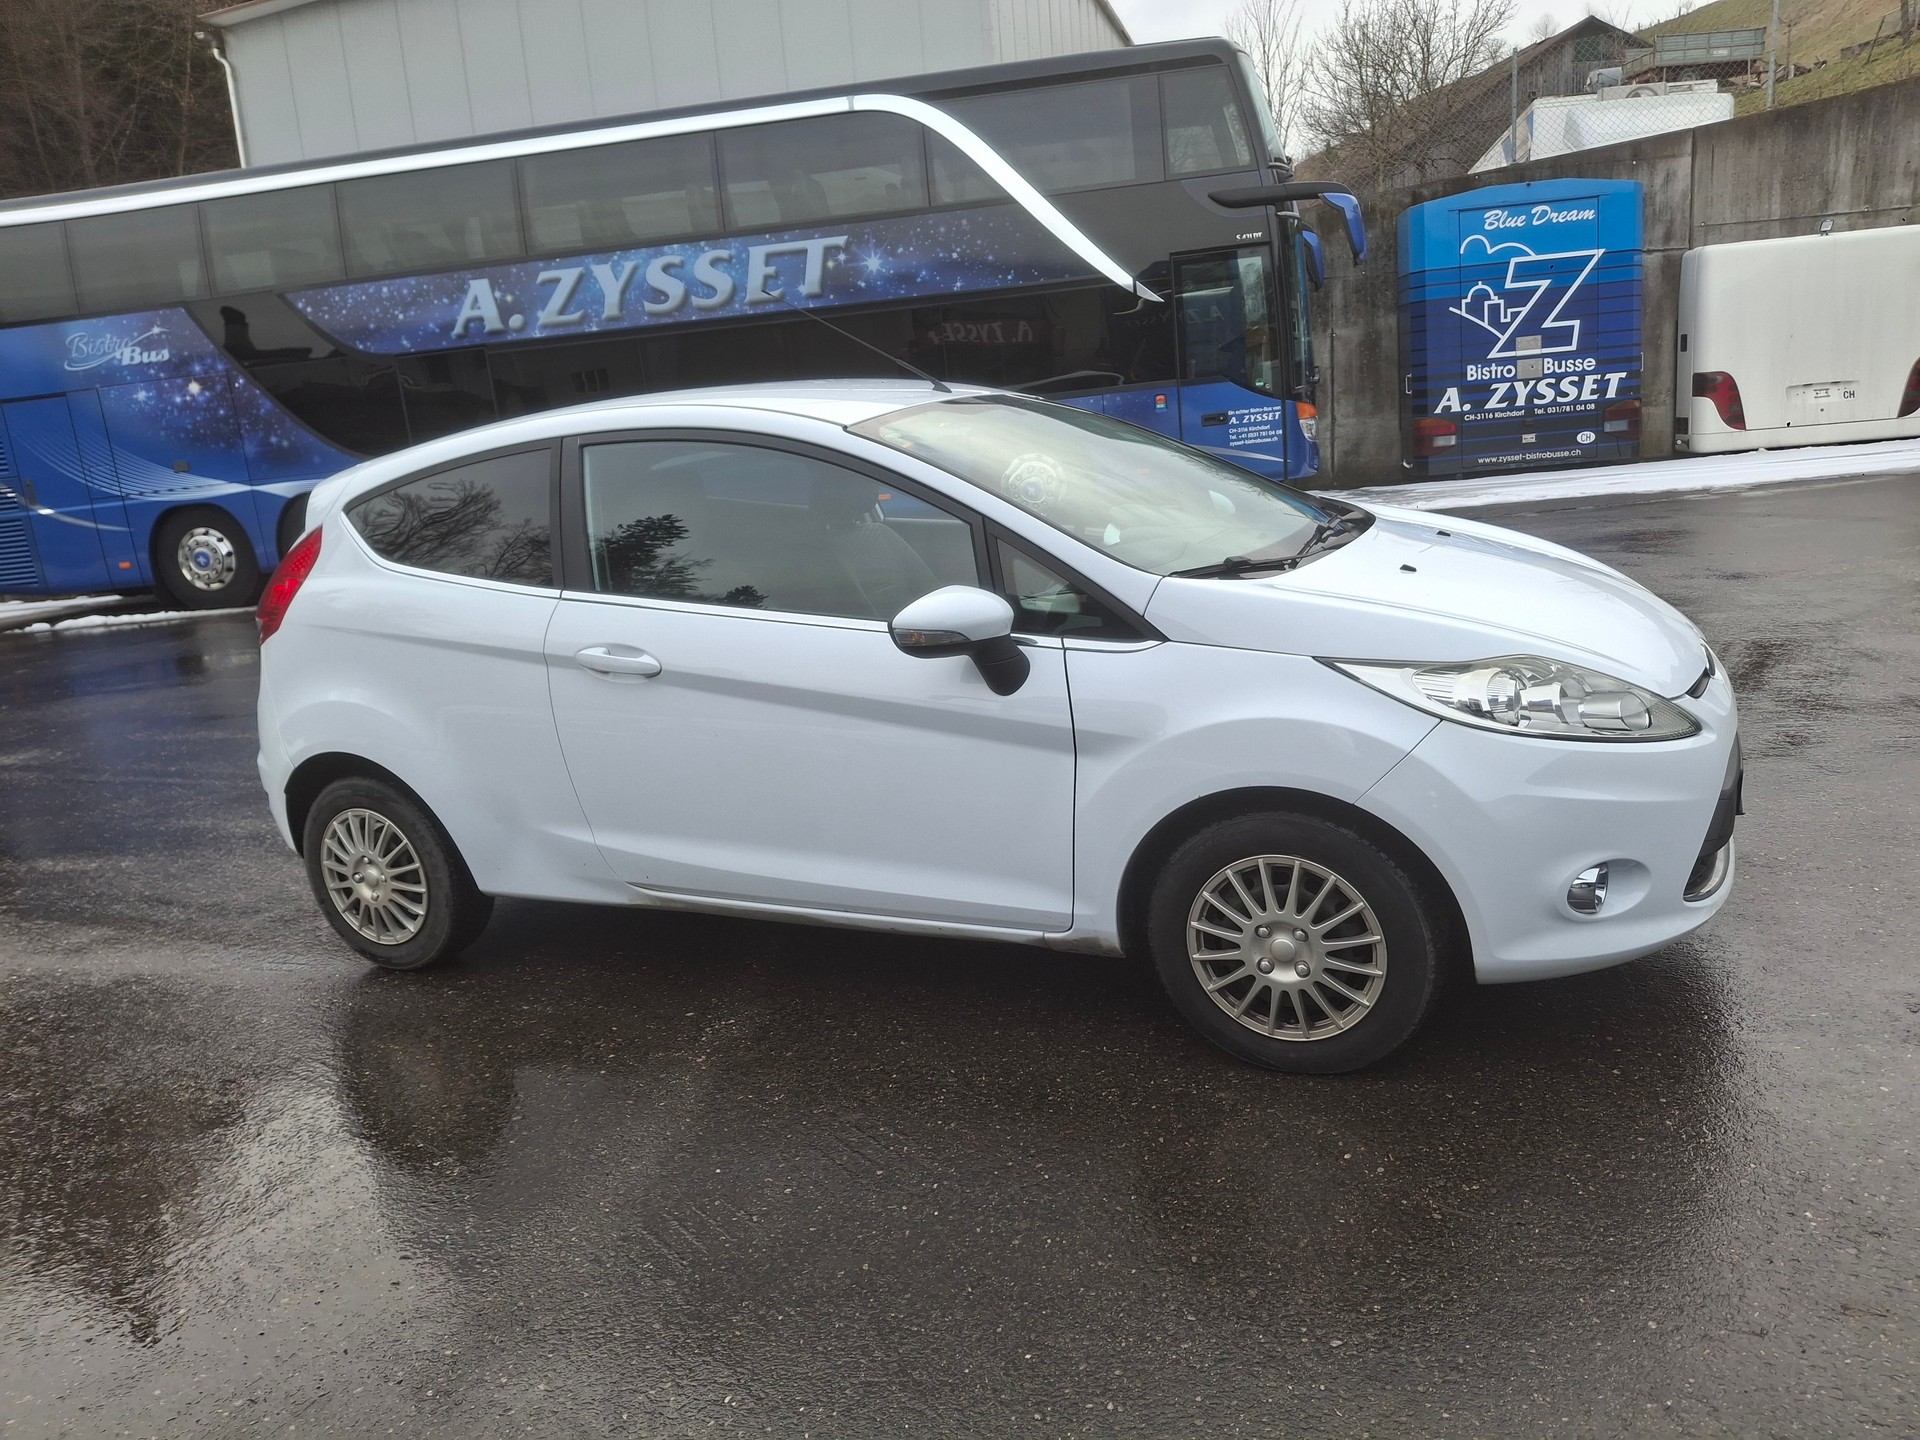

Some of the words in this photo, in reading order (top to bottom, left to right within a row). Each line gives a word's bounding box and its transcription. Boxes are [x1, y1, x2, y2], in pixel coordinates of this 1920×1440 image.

[1484, 209, 1526, 230] Blue
[1531, 205, 1595, 225] Dream
[450, 278, 526, 338] A.
[535, 234, 849, 327] ZYSSET
[66, 332, 130, 358] Bistro
[117, 345, 170, 366] Bus
[1466, 365, 1516, 381] Bistro
[1543, 358, 1596, 374] Busse
[1434, 387, 1472, 413] A.
[1484, 372, 1627, 409] ZYSSET
[1843, 390, 1855, 399] CH
[1229, 416, 1239, 424] A.
[1242, 412, 1281, 423] ZYSSET
[1465, 412, 1493, 421] CH-3116
[1495, 410, 1525, 418] Kirchdorf
[1547, 405, 1574, 414] 031/781
[1580, 433, 1591, 442] CH
[1478, 449, 1581, 464] www.zysset-bistrobusse.ch
